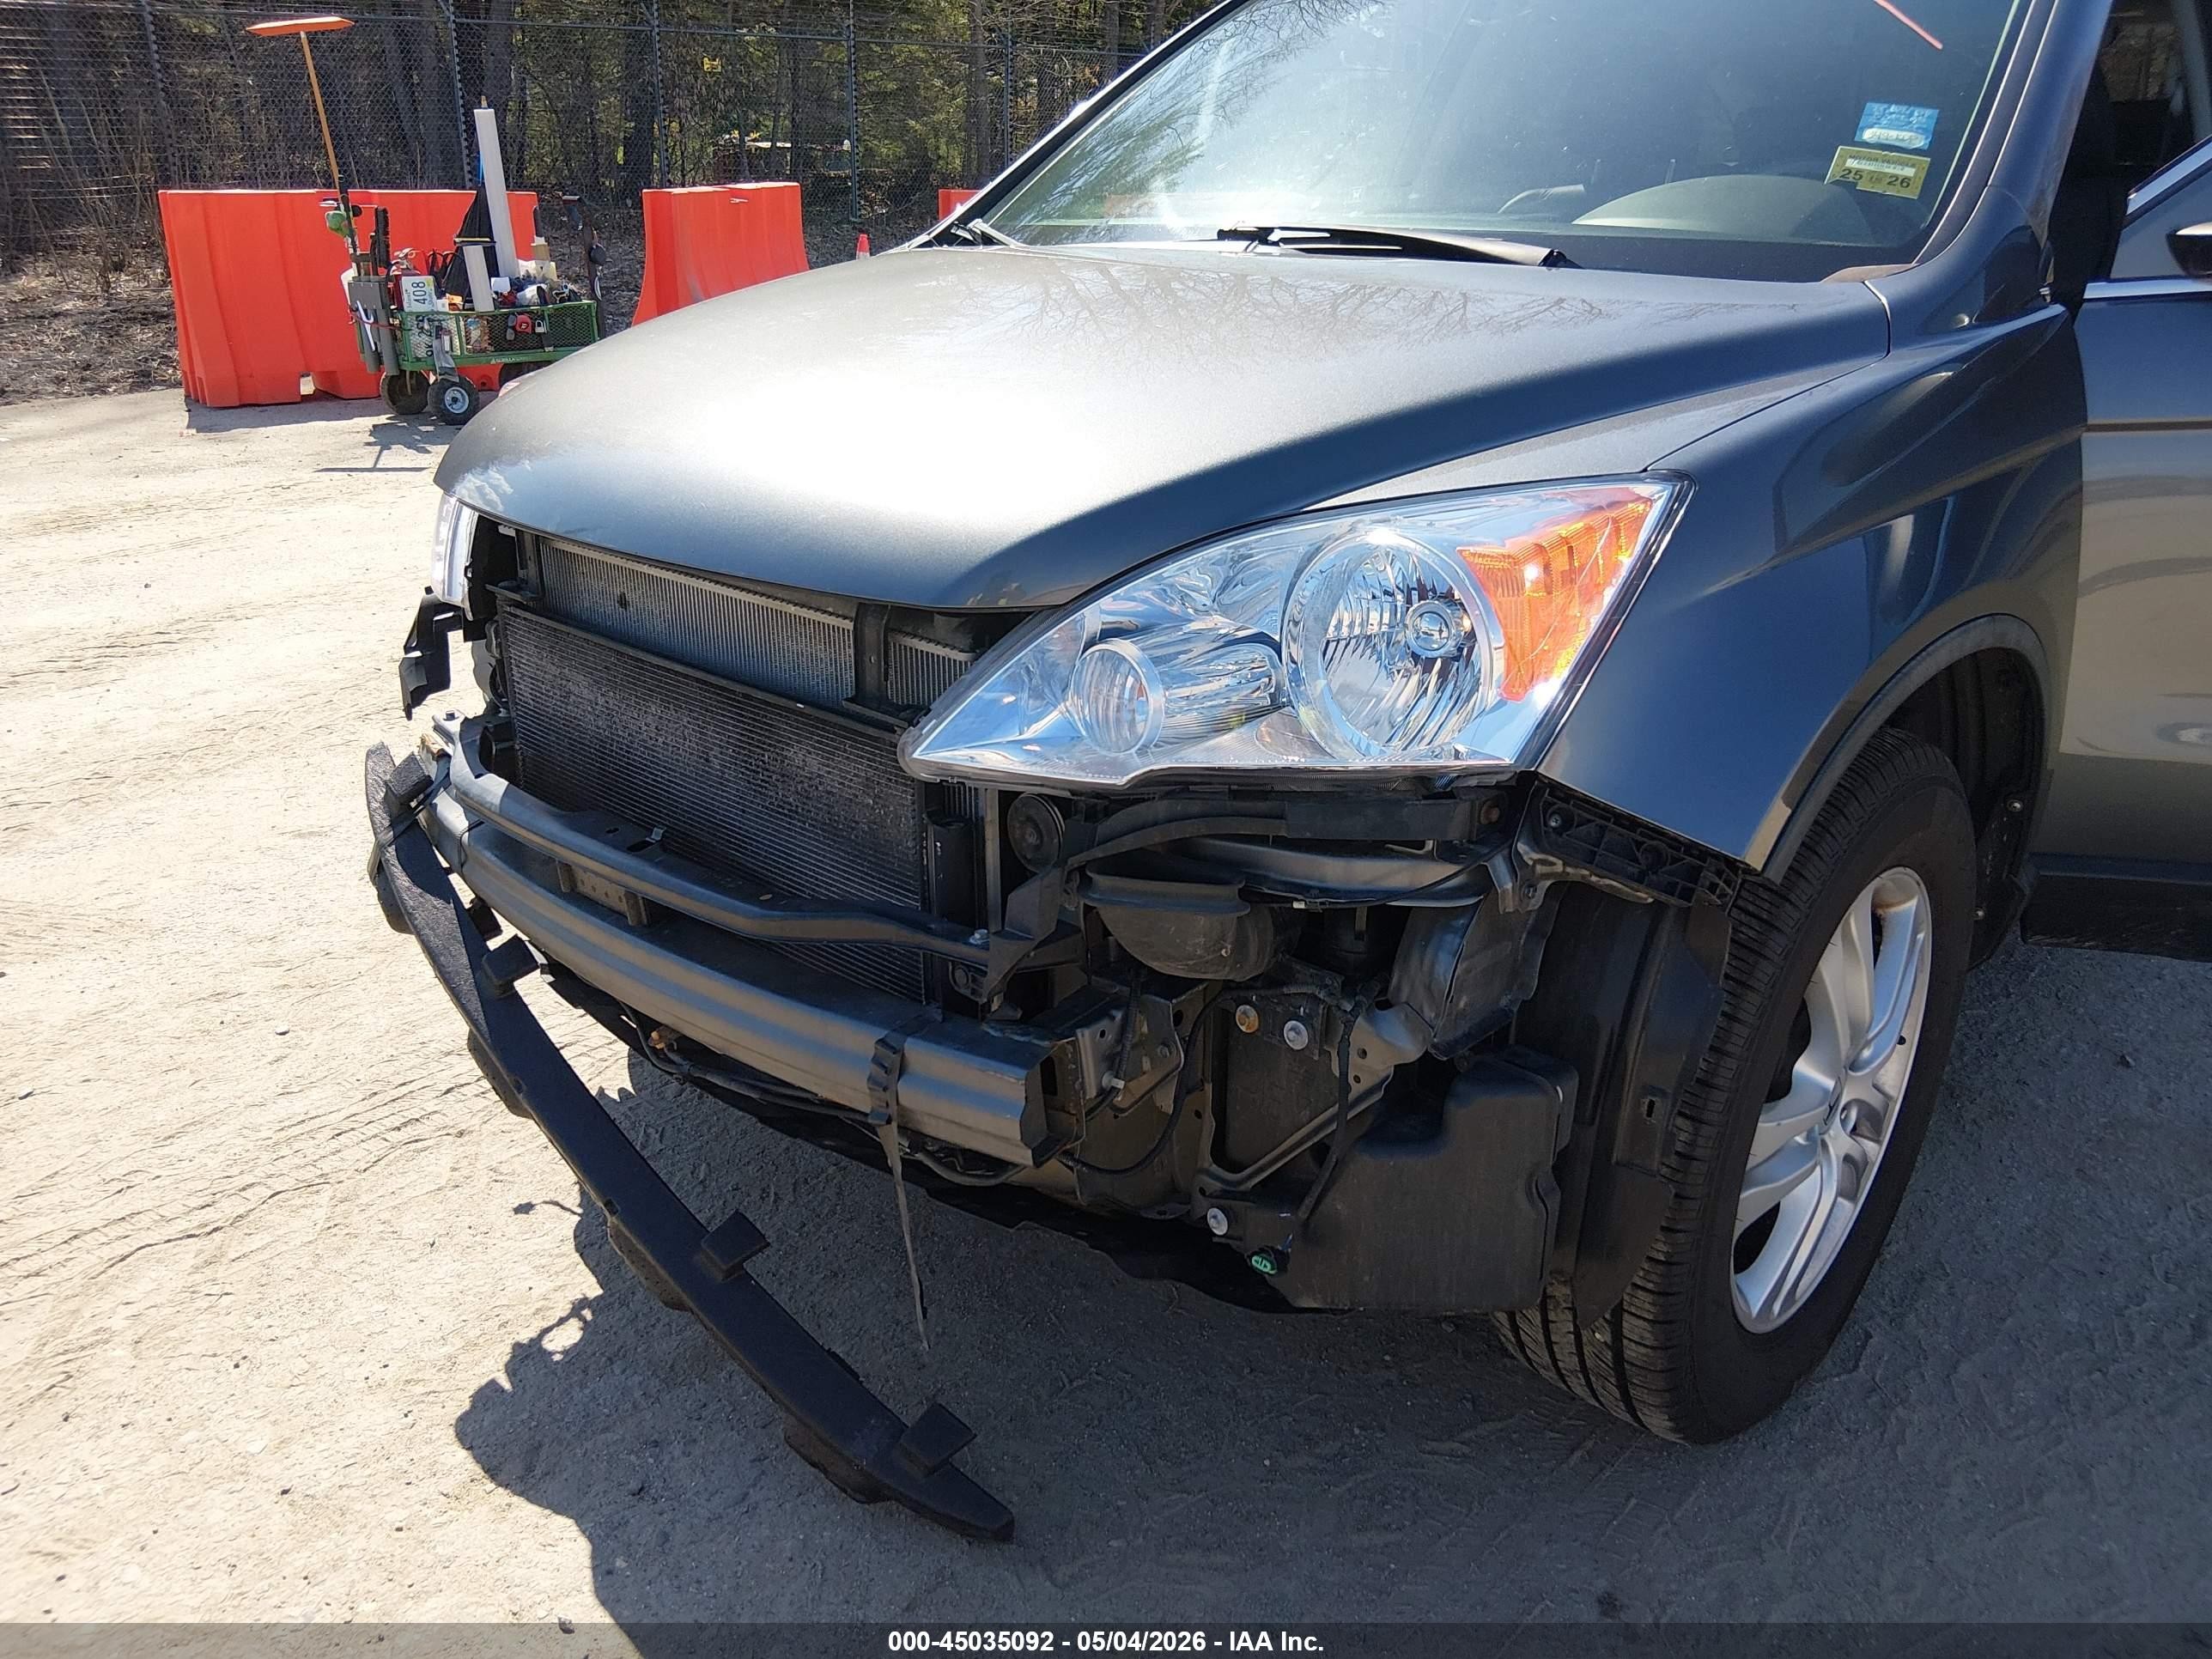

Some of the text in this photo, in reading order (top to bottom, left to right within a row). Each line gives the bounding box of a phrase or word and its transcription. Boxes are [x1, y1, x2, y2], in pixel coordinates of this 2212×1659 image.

[1839, 168, 1863, 181] 25
[1887, 174, 1912, 189] 26
[411, 281, 428, 305] 408
